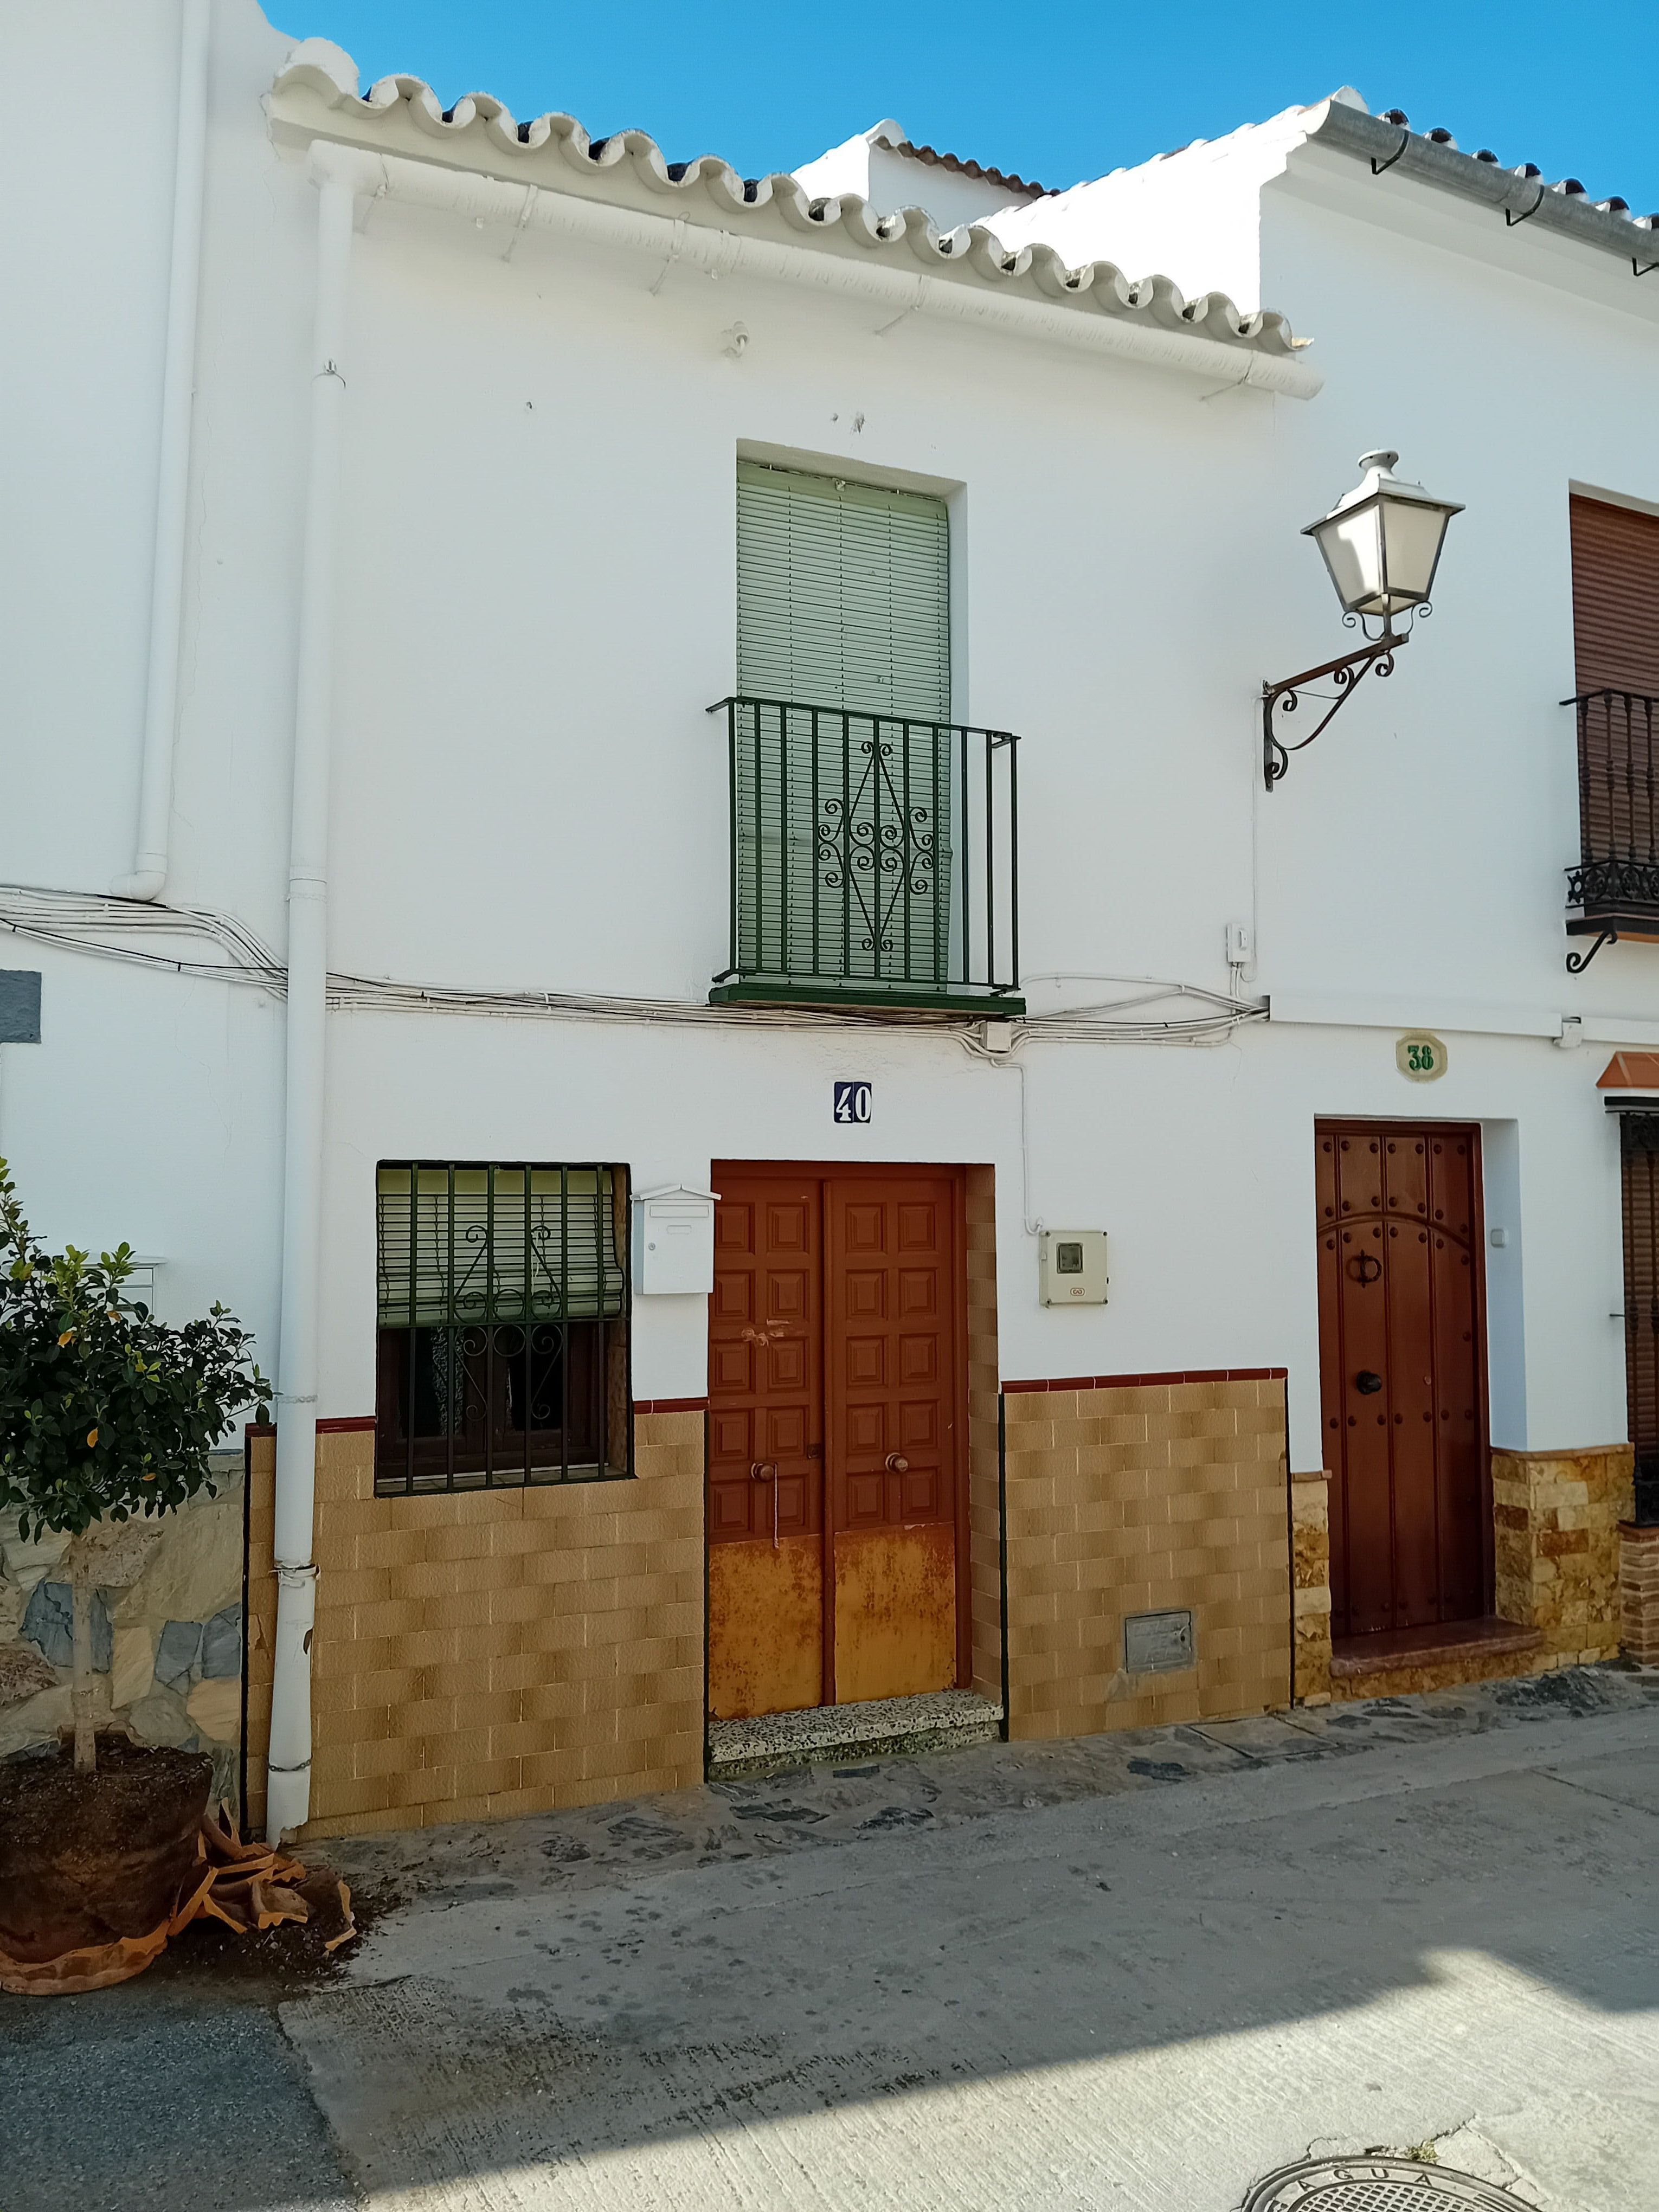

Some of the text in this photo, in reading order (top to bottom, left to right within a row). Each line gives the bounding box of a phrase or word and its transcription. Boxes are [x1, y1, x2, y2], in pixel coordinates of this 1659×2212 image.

[1407, 1045, 1434, 1071] 38
[835, 1086, 872, 1121] 40
[1297, 2168, 1433, 2192] AGUA
